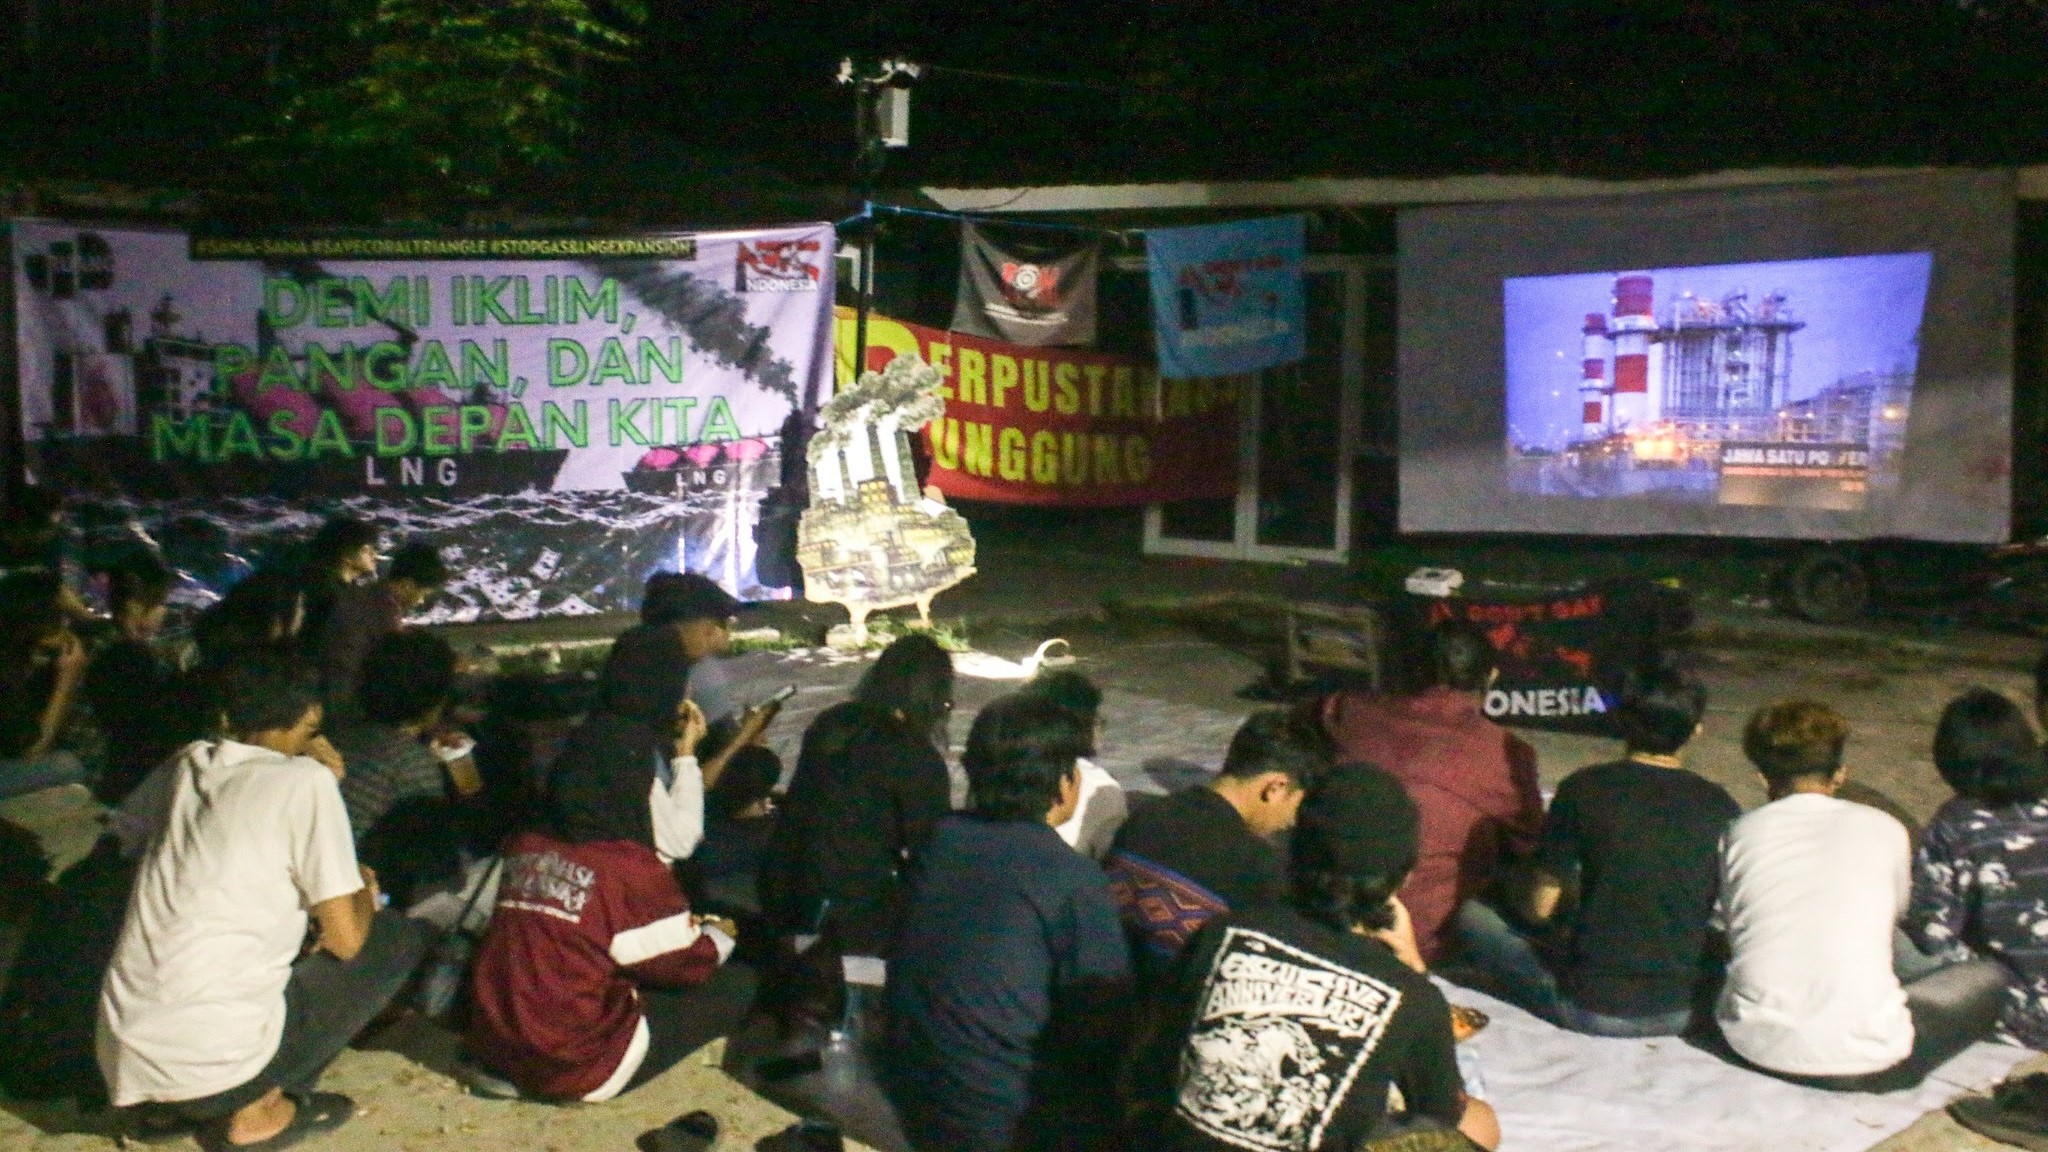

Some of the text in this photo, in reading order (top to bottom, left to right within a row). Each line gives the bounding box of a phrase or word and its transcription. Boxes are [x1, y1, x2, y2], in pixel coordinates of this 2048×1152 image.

[262, 274, 636, 334] DEMI IKLIM,
[212, 336, 683, 397] PANGAN, DAN
[150, 396, 743, 462] MASA DEPAN KITA
[366, 456, 459, 485] LNG
[676, 469, 726, 487] LNG
[1767, 450, 1805, 465] SATU
